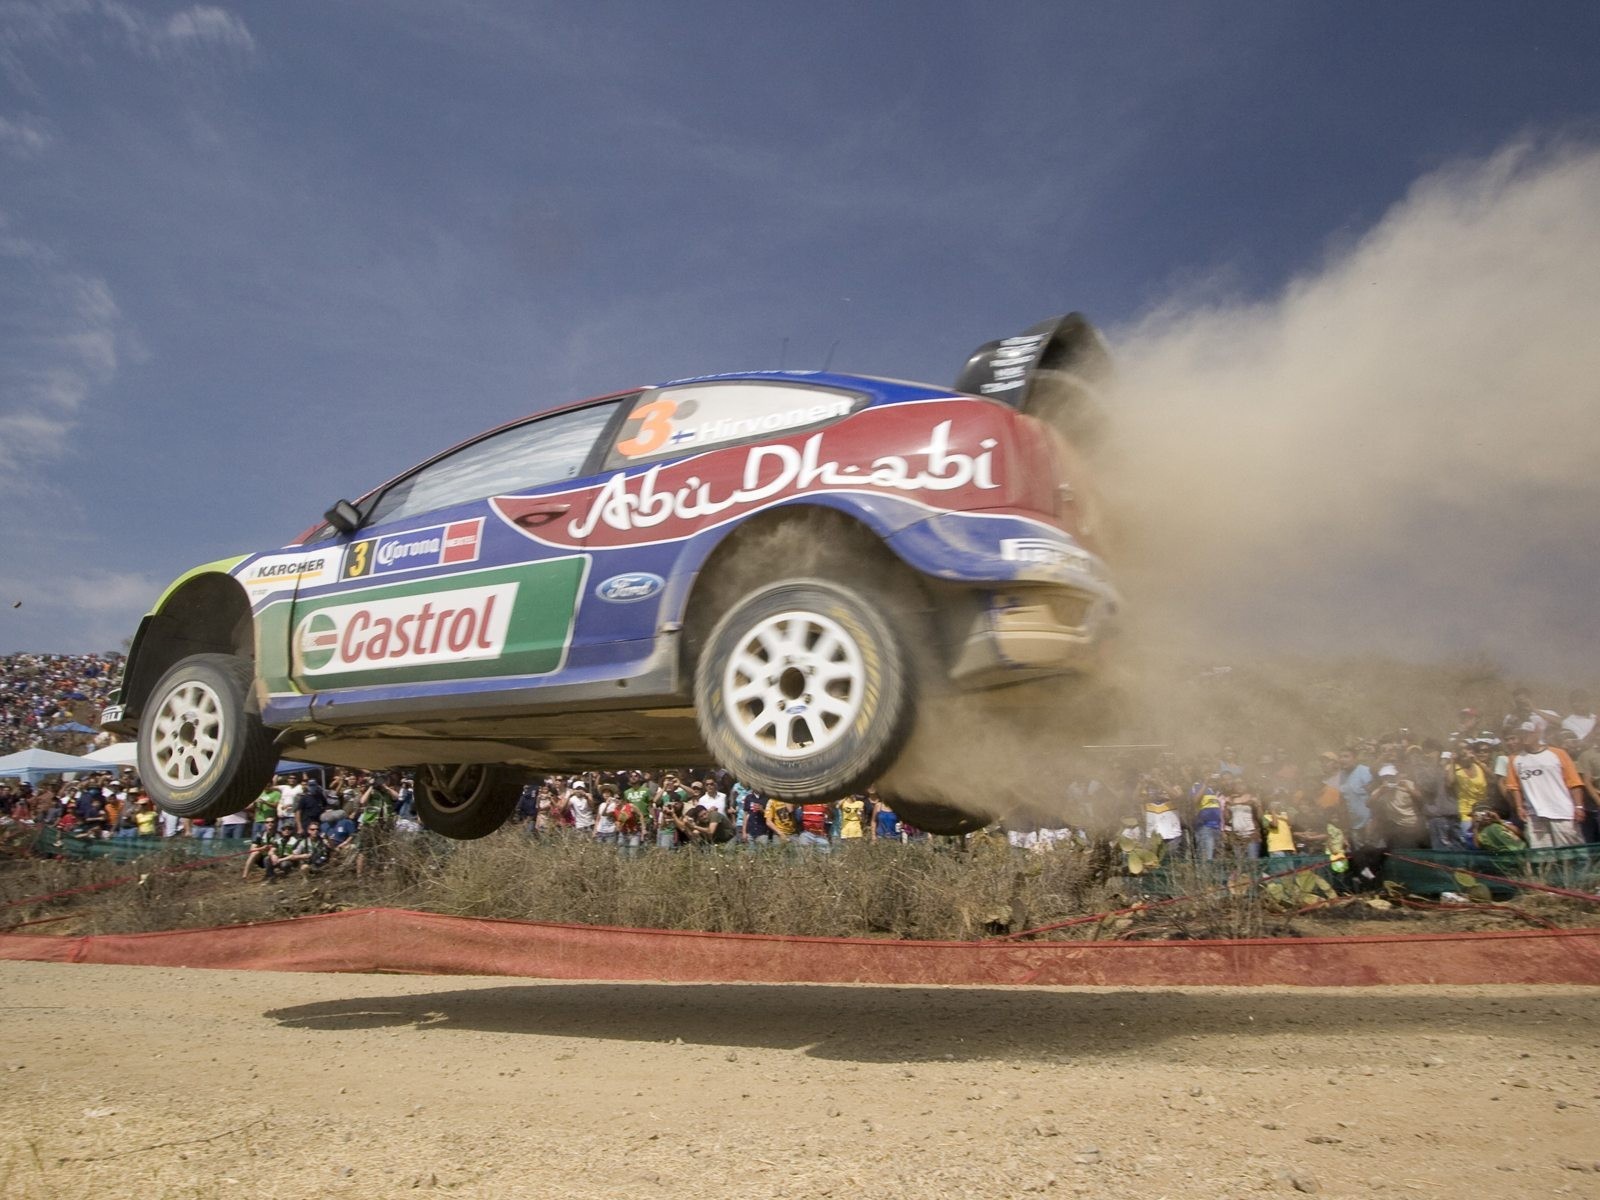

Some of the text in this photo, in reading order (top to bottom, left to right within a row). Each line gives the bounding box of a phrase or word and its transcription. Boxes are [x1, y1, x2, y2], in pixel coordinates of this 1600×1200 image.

[617, 399, 852, 456] 3 Hirvonen
[567, 420, 1002, 539] Abu Dhabi
[350, 541, 369, 577] 3
[377, 538, 440, 566] Corona
[606, 577, 653, 598] Ford
[341, 594, 497, 664] Castrol
